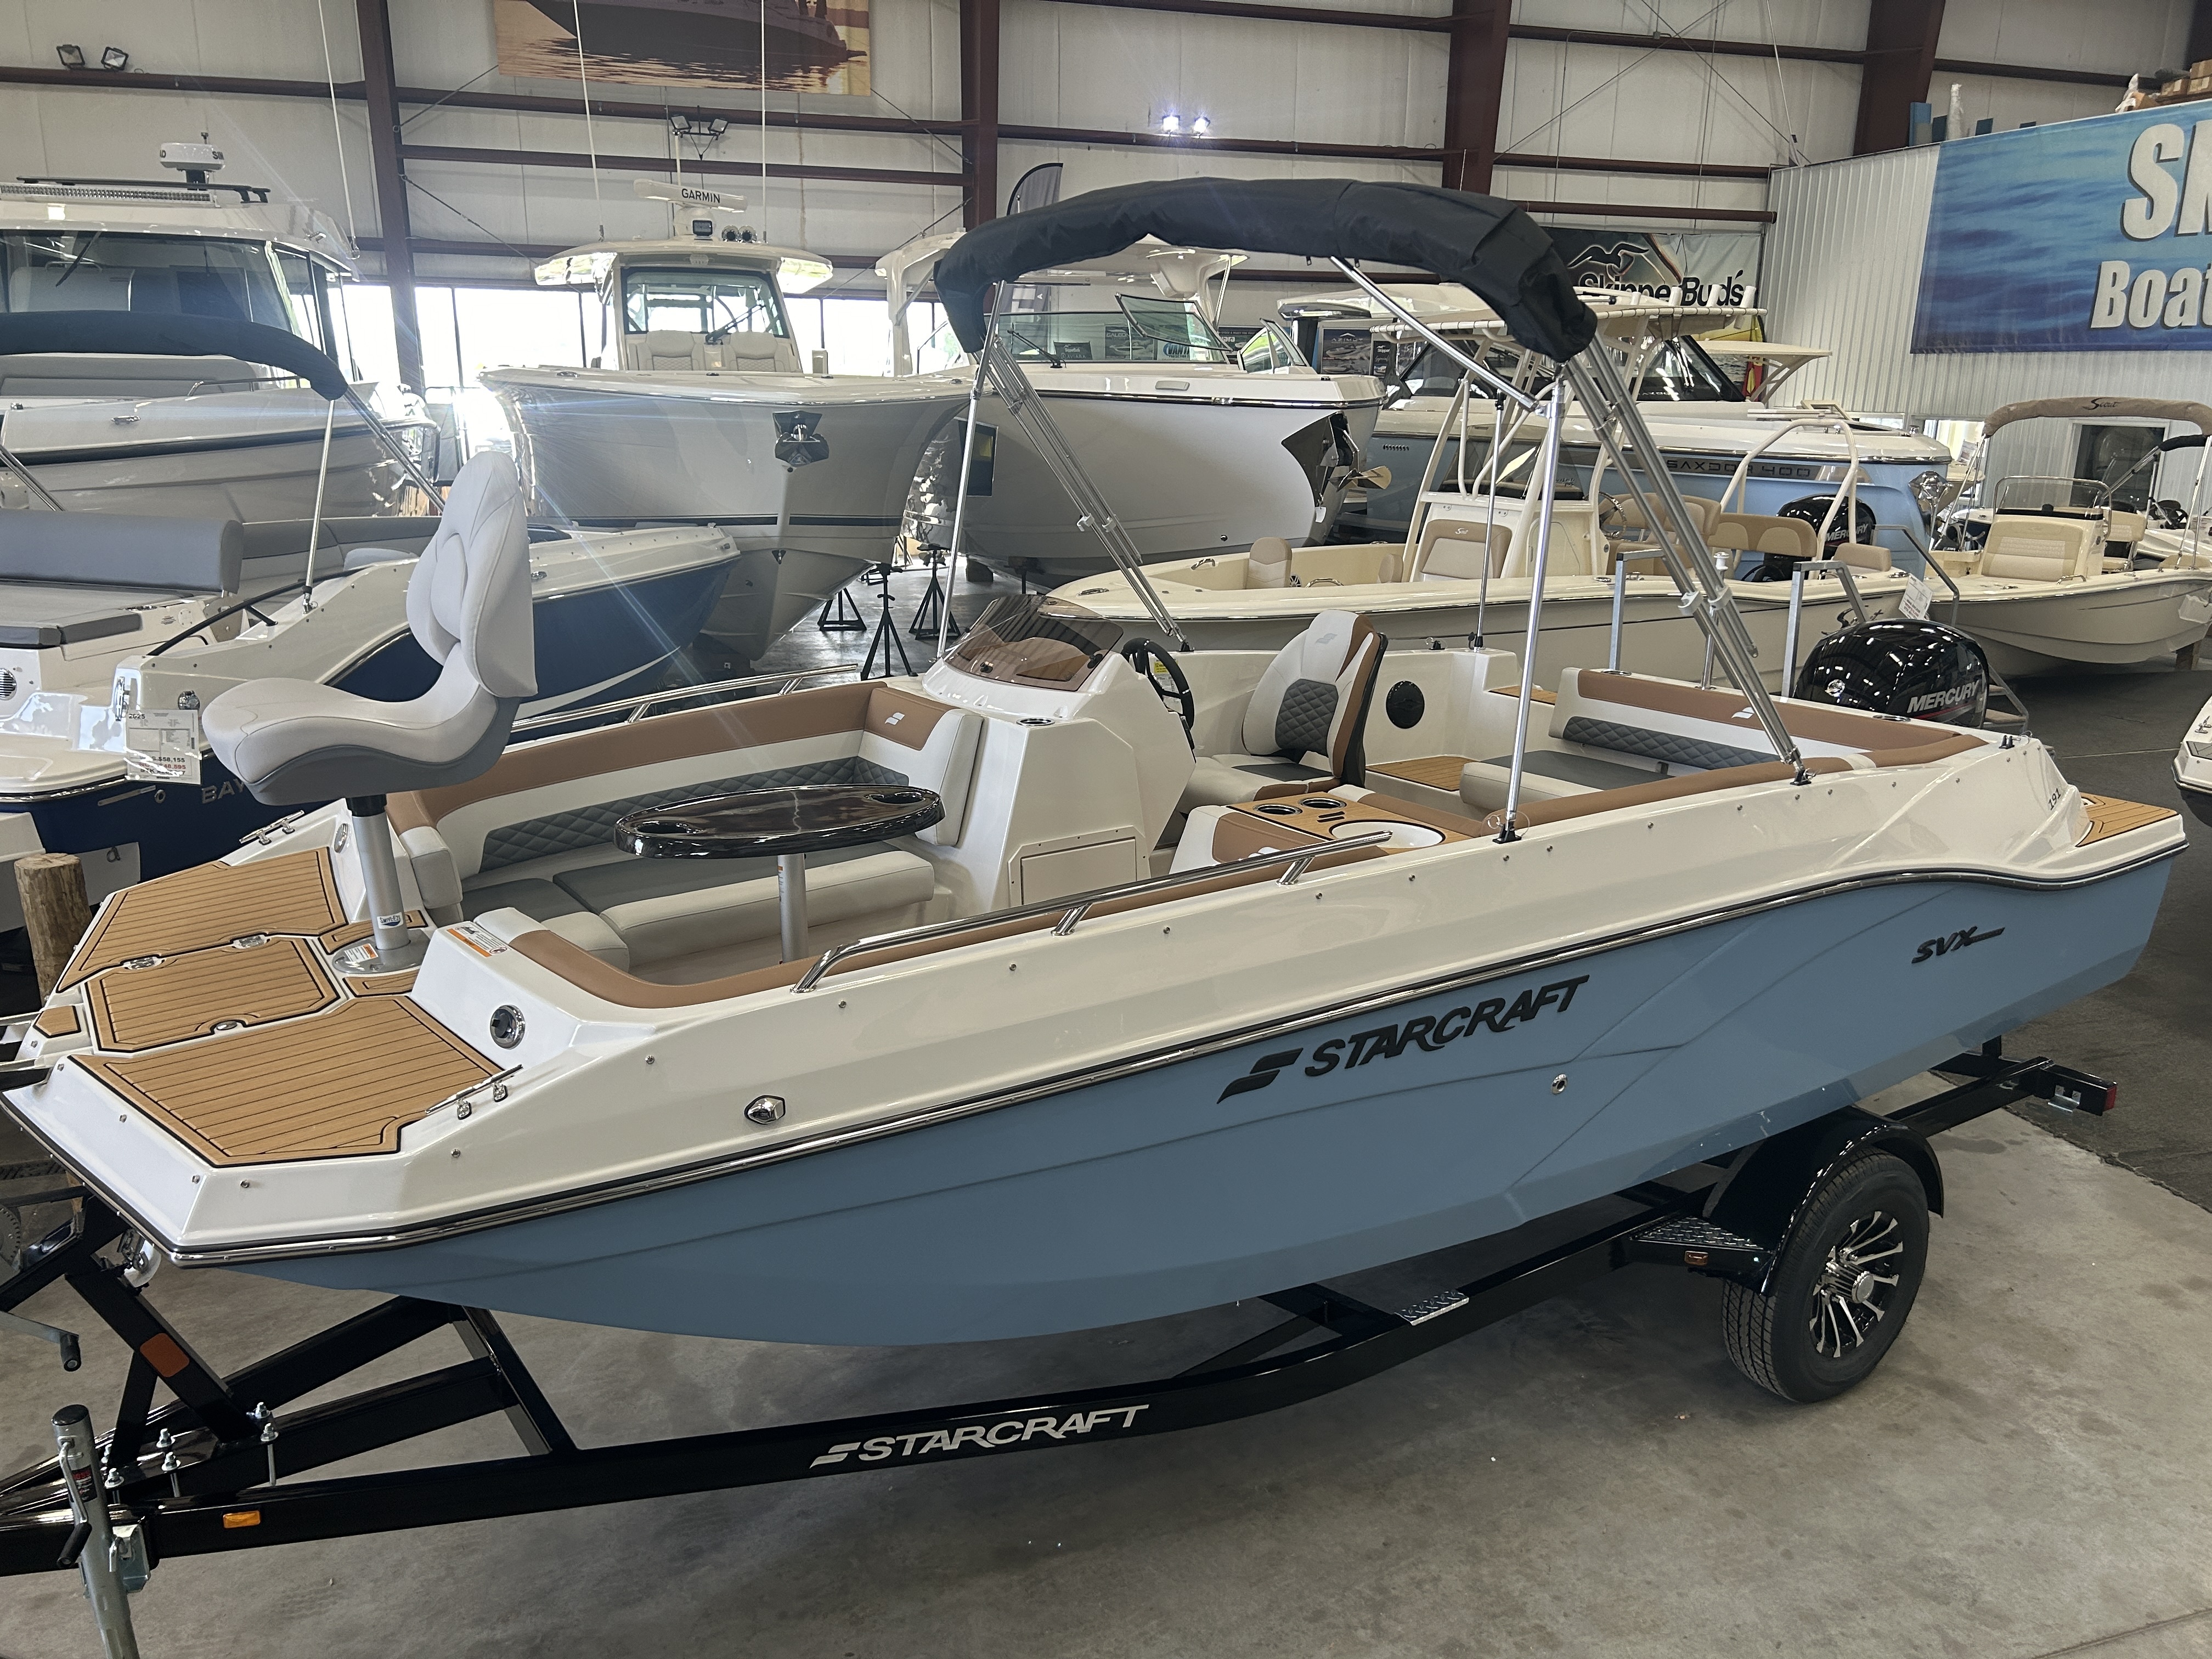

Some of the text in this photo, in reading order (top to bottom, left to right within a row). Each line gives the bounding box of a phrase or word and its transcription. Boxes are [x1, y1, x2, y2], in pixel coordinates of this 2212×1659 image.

[681, 188, 720, 204] GARMIN
[1761, 465, 1810, 477] 400
[1825, 523, 1869, 541] MERRY
[1906, 679, 1979, 713] MERCURY
[2048, 788, 2061, 811] 191
[1911, 926, 2005, 964] SVX
[1305, 974, 1590, 1077] STARCRAFT
[859, 1404, 1150, 1461] STARCRAFT
